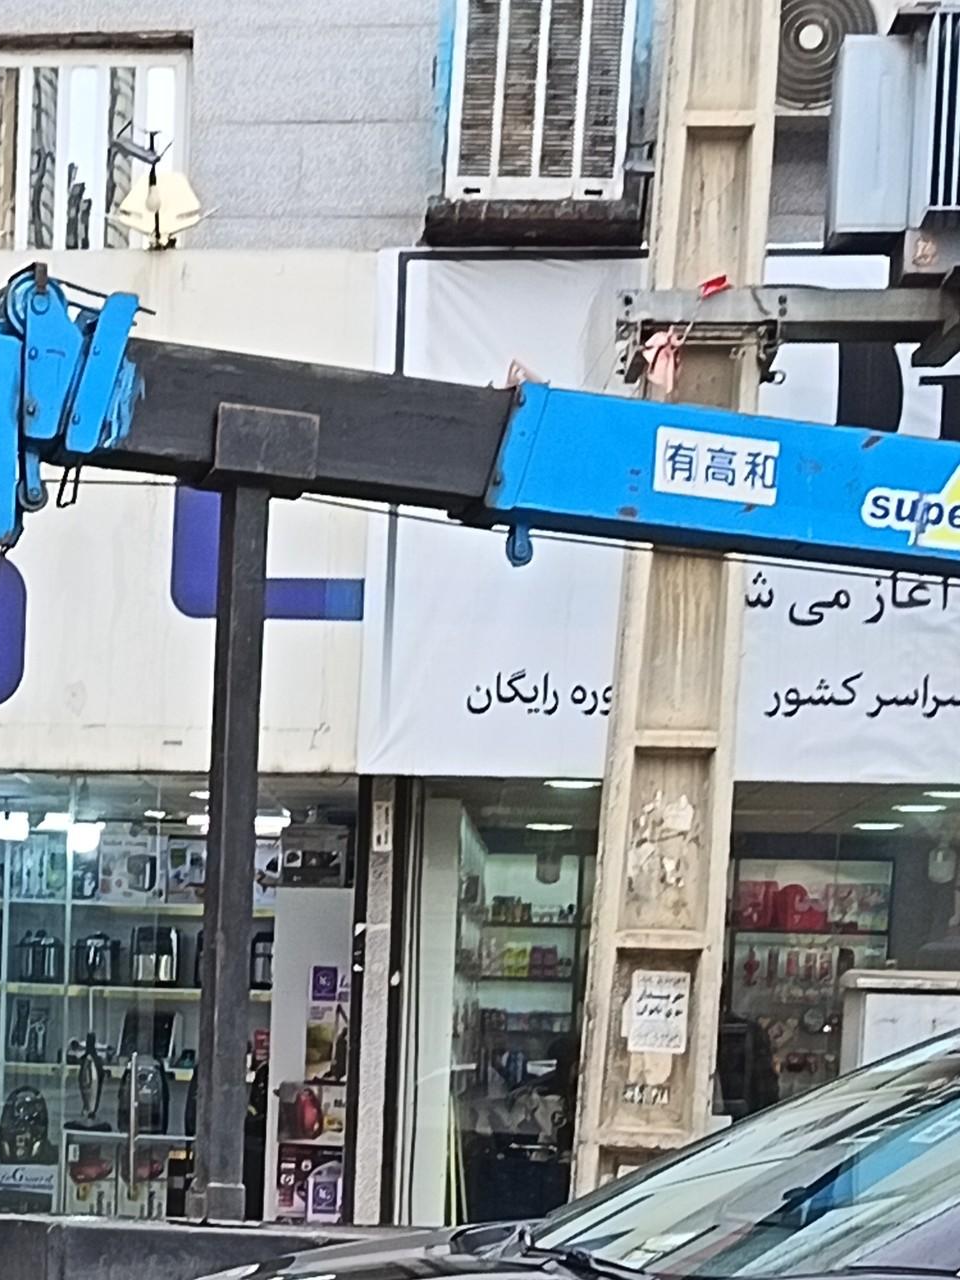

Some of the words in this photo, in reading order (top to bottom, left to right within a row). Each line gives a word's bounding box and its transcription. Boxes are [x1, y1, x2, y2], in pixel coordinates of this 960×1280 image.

[788, 589, 850, 626] می
[467, 668, 559, 715] رایگان
[764, 672, 863, 717] کشور
